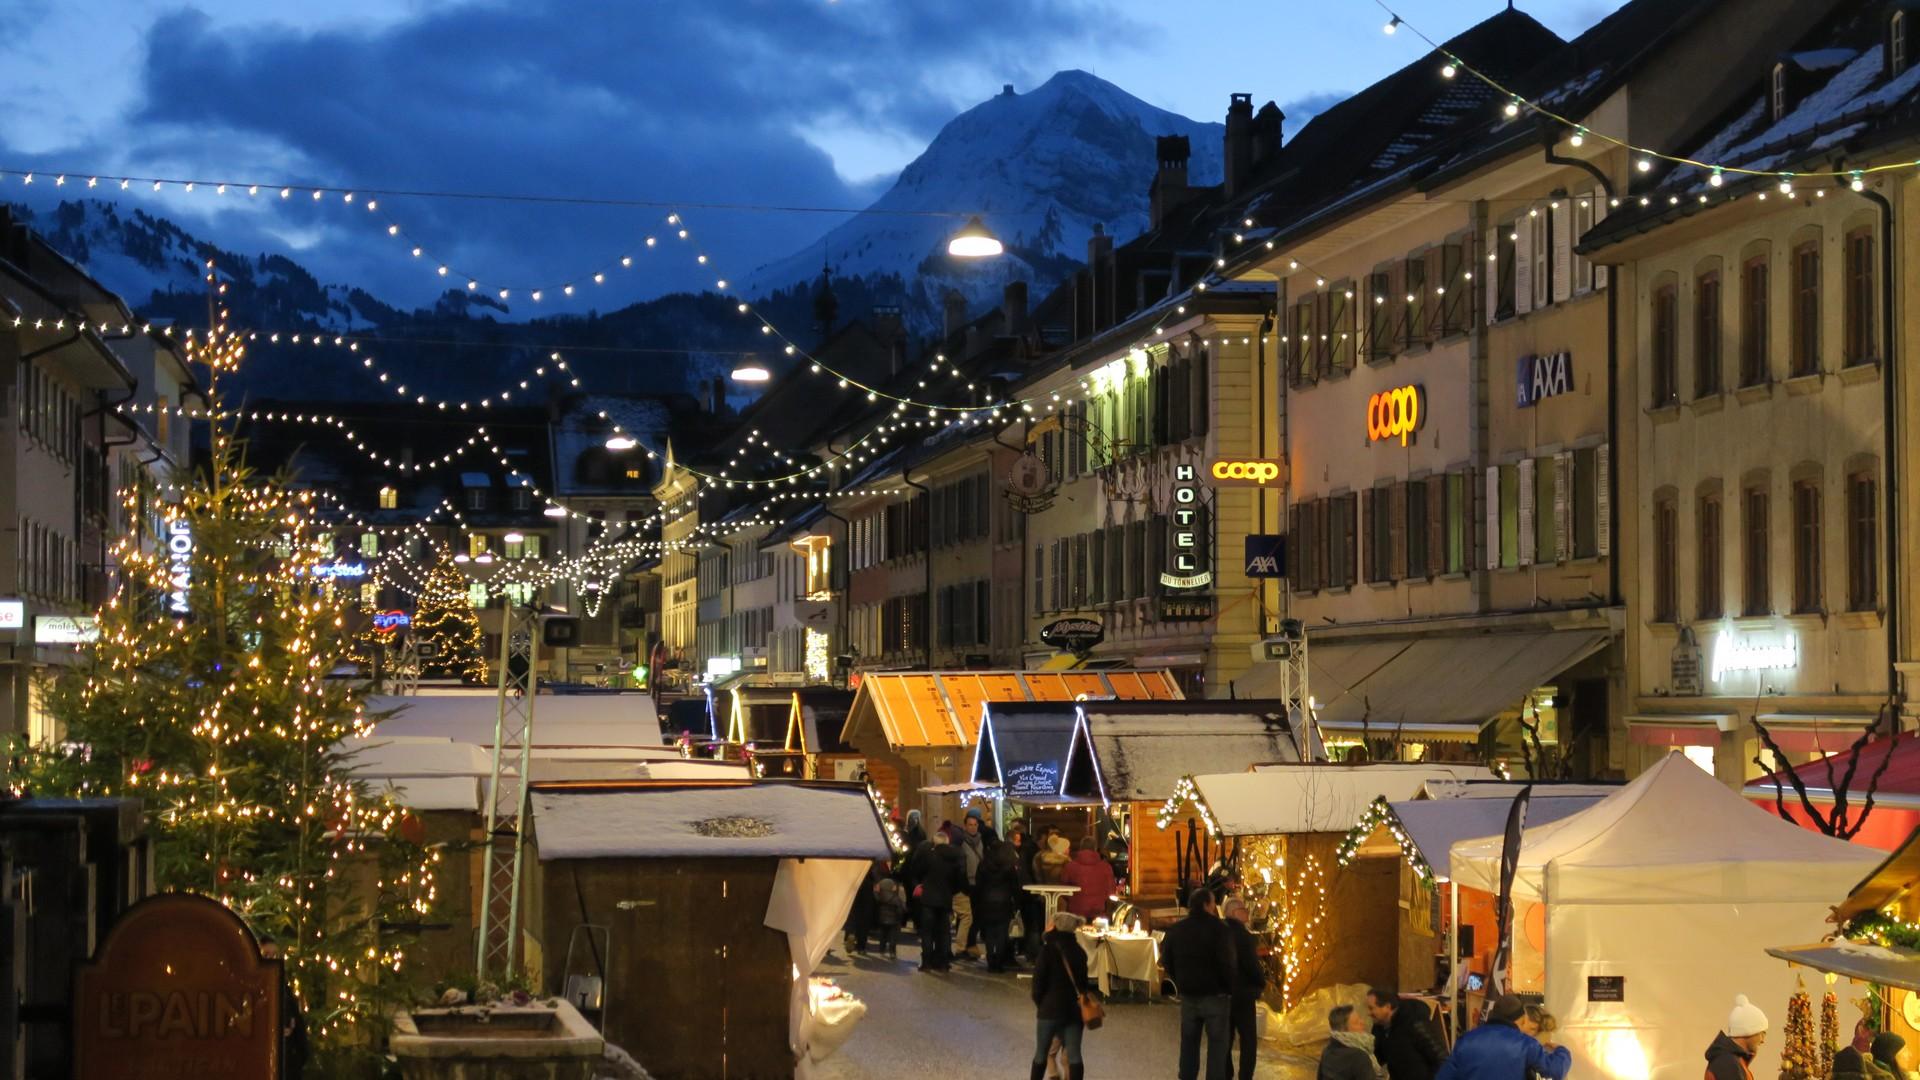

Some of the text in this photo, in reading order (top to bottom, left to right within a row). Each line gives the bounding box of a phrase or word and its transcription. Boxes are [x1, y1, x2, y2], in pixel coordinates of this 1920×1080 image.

[1532, 353, 1567, 401] AXA
[1367, 385, 1417, 447] coop
[1212, 461, 1279, 484] coop
[1177, 466, 1195, 570] HOTEL
[1173, 575, 1209, 587] TONNELIER
[1246, 556, 1279, 573] AXA
[129, 991, 252, 1038] PAIN
